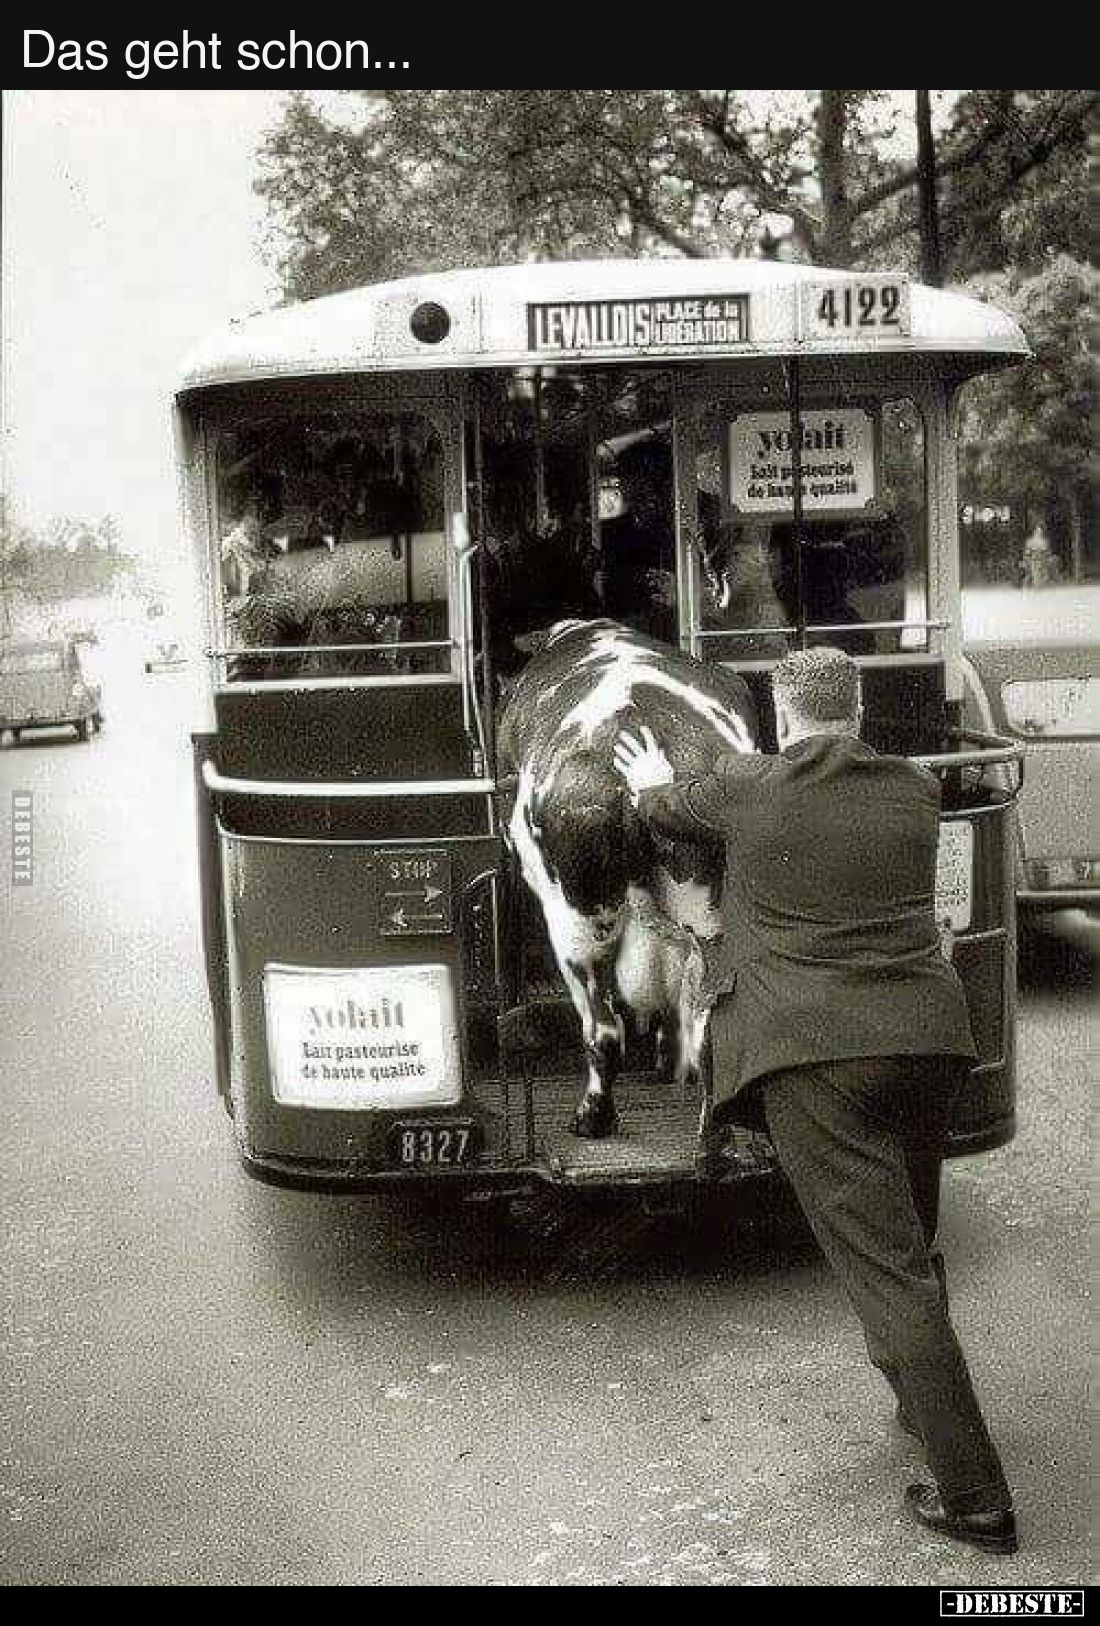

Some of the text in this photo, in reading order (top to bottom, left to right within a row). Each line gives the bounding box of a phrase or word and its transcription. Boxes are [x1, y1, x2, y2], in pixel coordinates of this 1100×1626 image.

[656, 302, 703, 321] PLACE
[818, 287, 901, 327] 4122
[535, 302, 650, 349] LEVALLOIS
[302, 1064, 318, 1079] de
[402, 1130, 469, 1162] 8327
